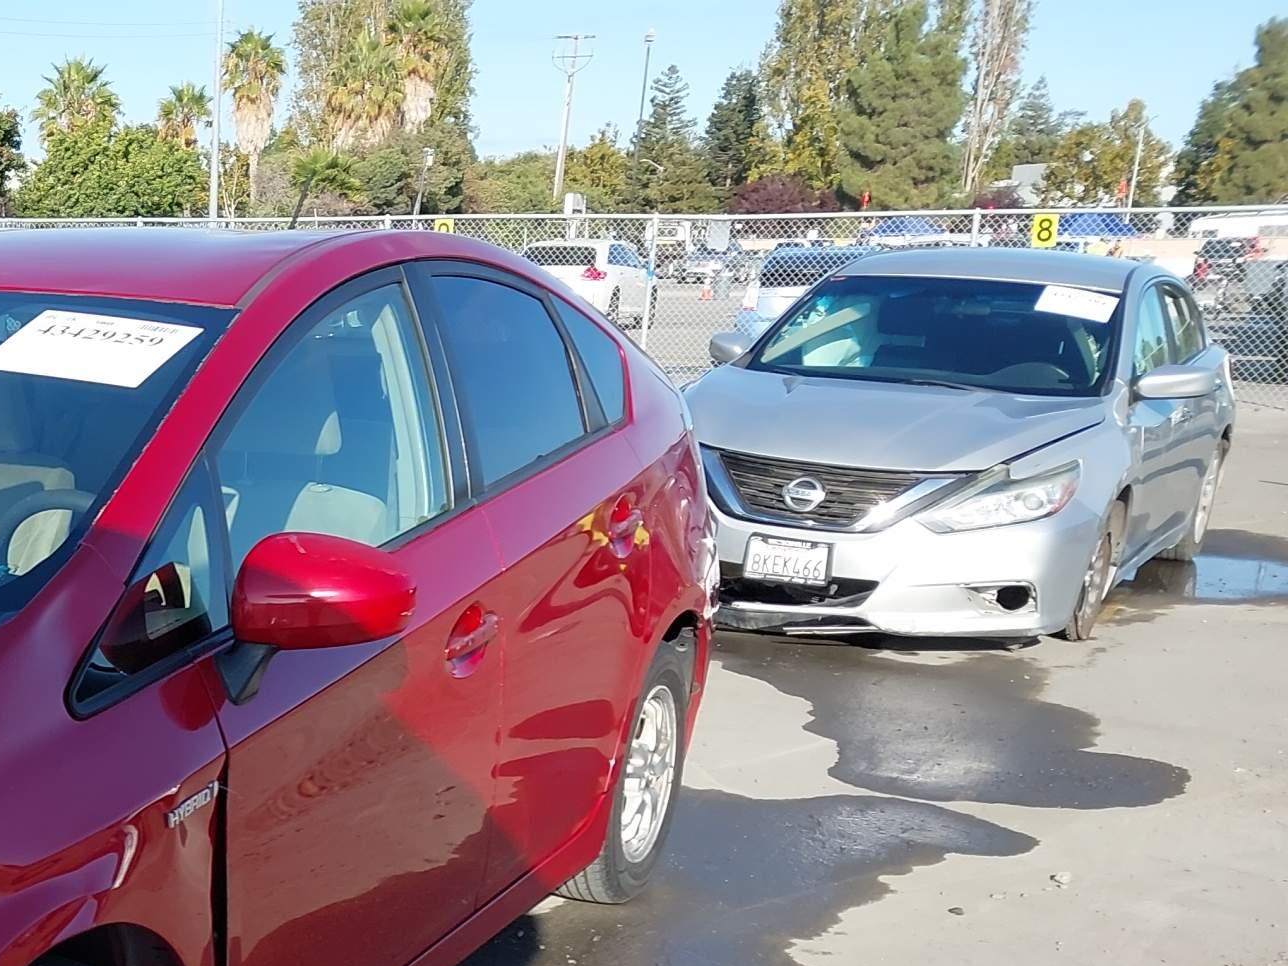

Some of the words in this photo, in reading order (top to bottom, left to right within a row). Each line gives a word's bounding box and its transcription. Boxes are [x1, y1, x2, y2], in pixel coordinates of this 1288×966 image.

[1037, 218, 1053, 242] 8
[38, 323, 165, 347] 43429259
[751, 552, 824, 579] 8KEK466
